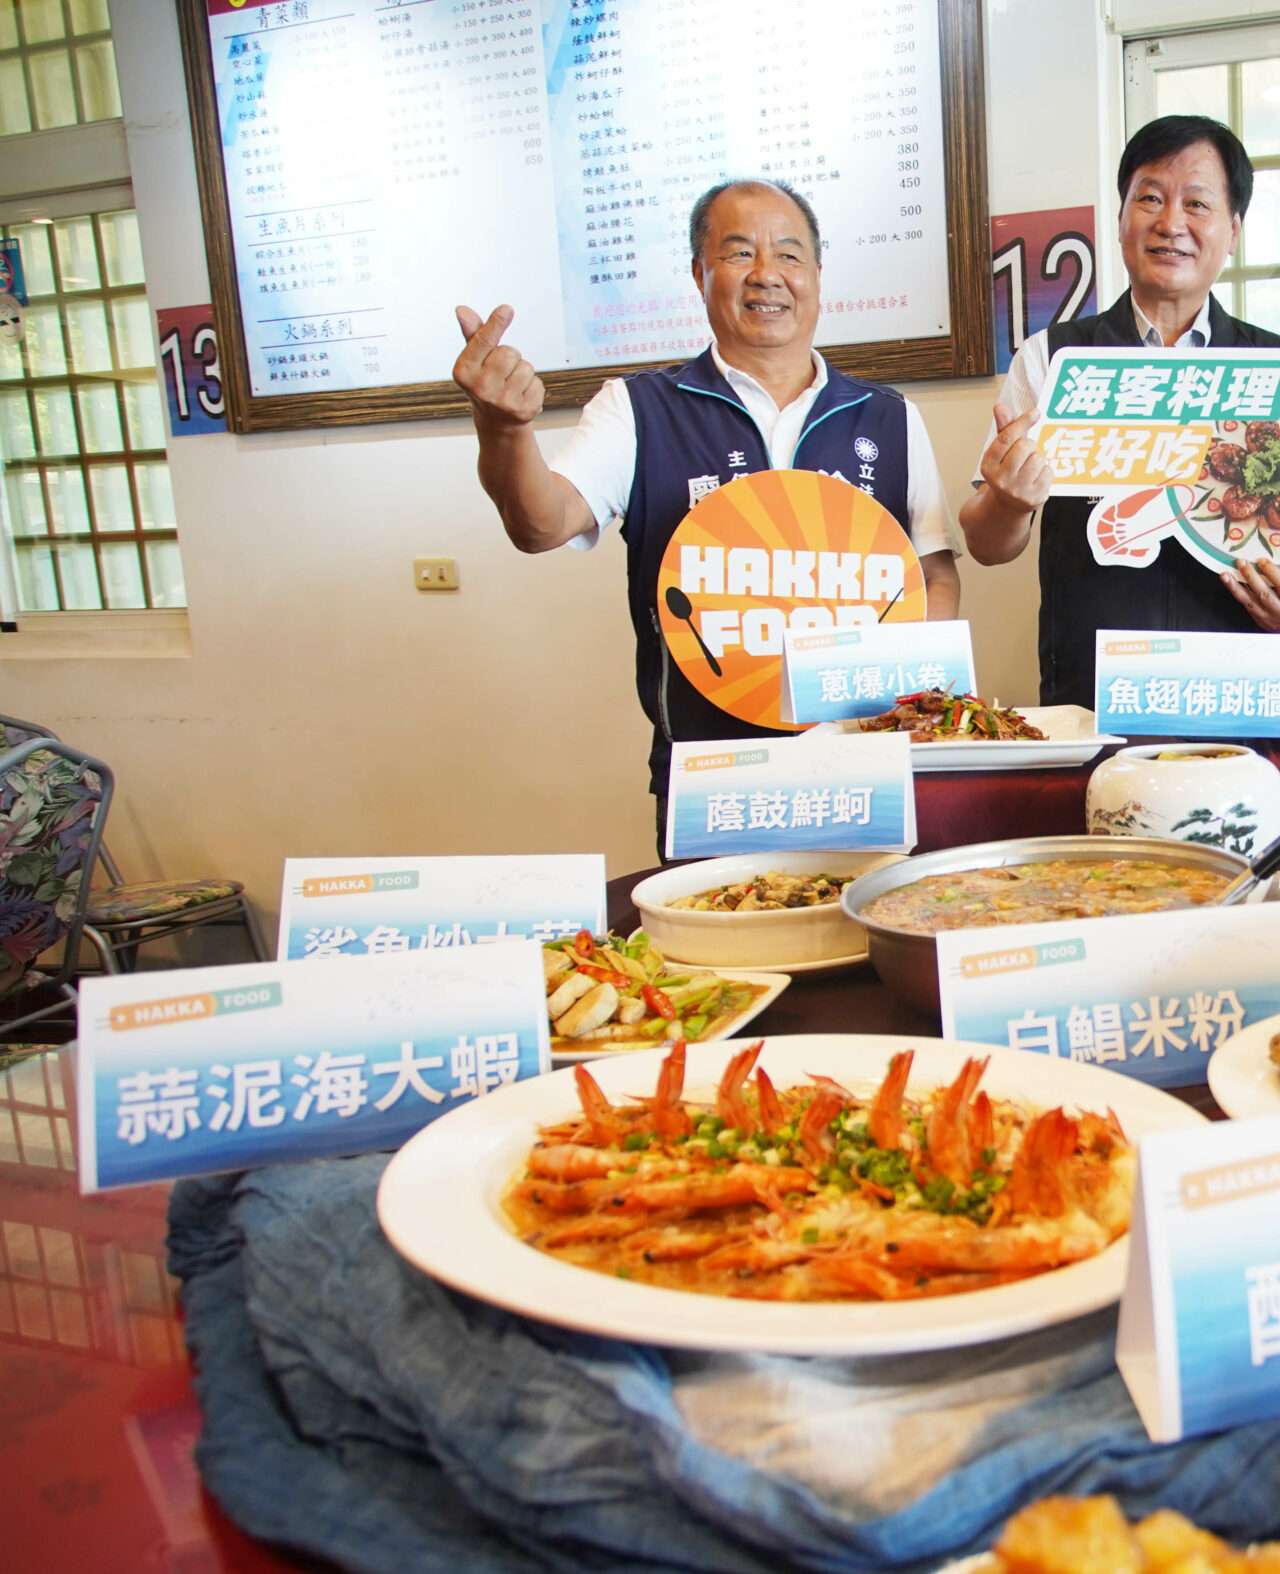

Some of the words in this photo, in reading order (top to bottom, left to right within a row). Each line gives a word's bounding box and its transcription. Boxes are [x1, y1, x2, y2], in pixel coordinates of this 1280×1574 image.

[897, 143, 919, 155] 380
[898, 159, 919, 172] 380
[899, 177, 921, 189] 450
[900, 204, 922, 217] 500
[990, 231, 1096, 355] 12
[160, 323, 226, 420] 13
[1040, 426, 1210, 479] 恁好吃
[680, 545, 905, 602] HAKKA
[706, 786, 873, 832] 蔭鼓鮮蚵
[318, 880, 367, 893] HAKKA
[378, 874, 412, 888] FOOD
[977, 952, 1030, 971] HAKKA
[133, 1001, 206, 1023] HAKKA
[222, 989, 271, 1008] FOOD
[115, 1032, 519, 1147] 蒜泥海大蝦
